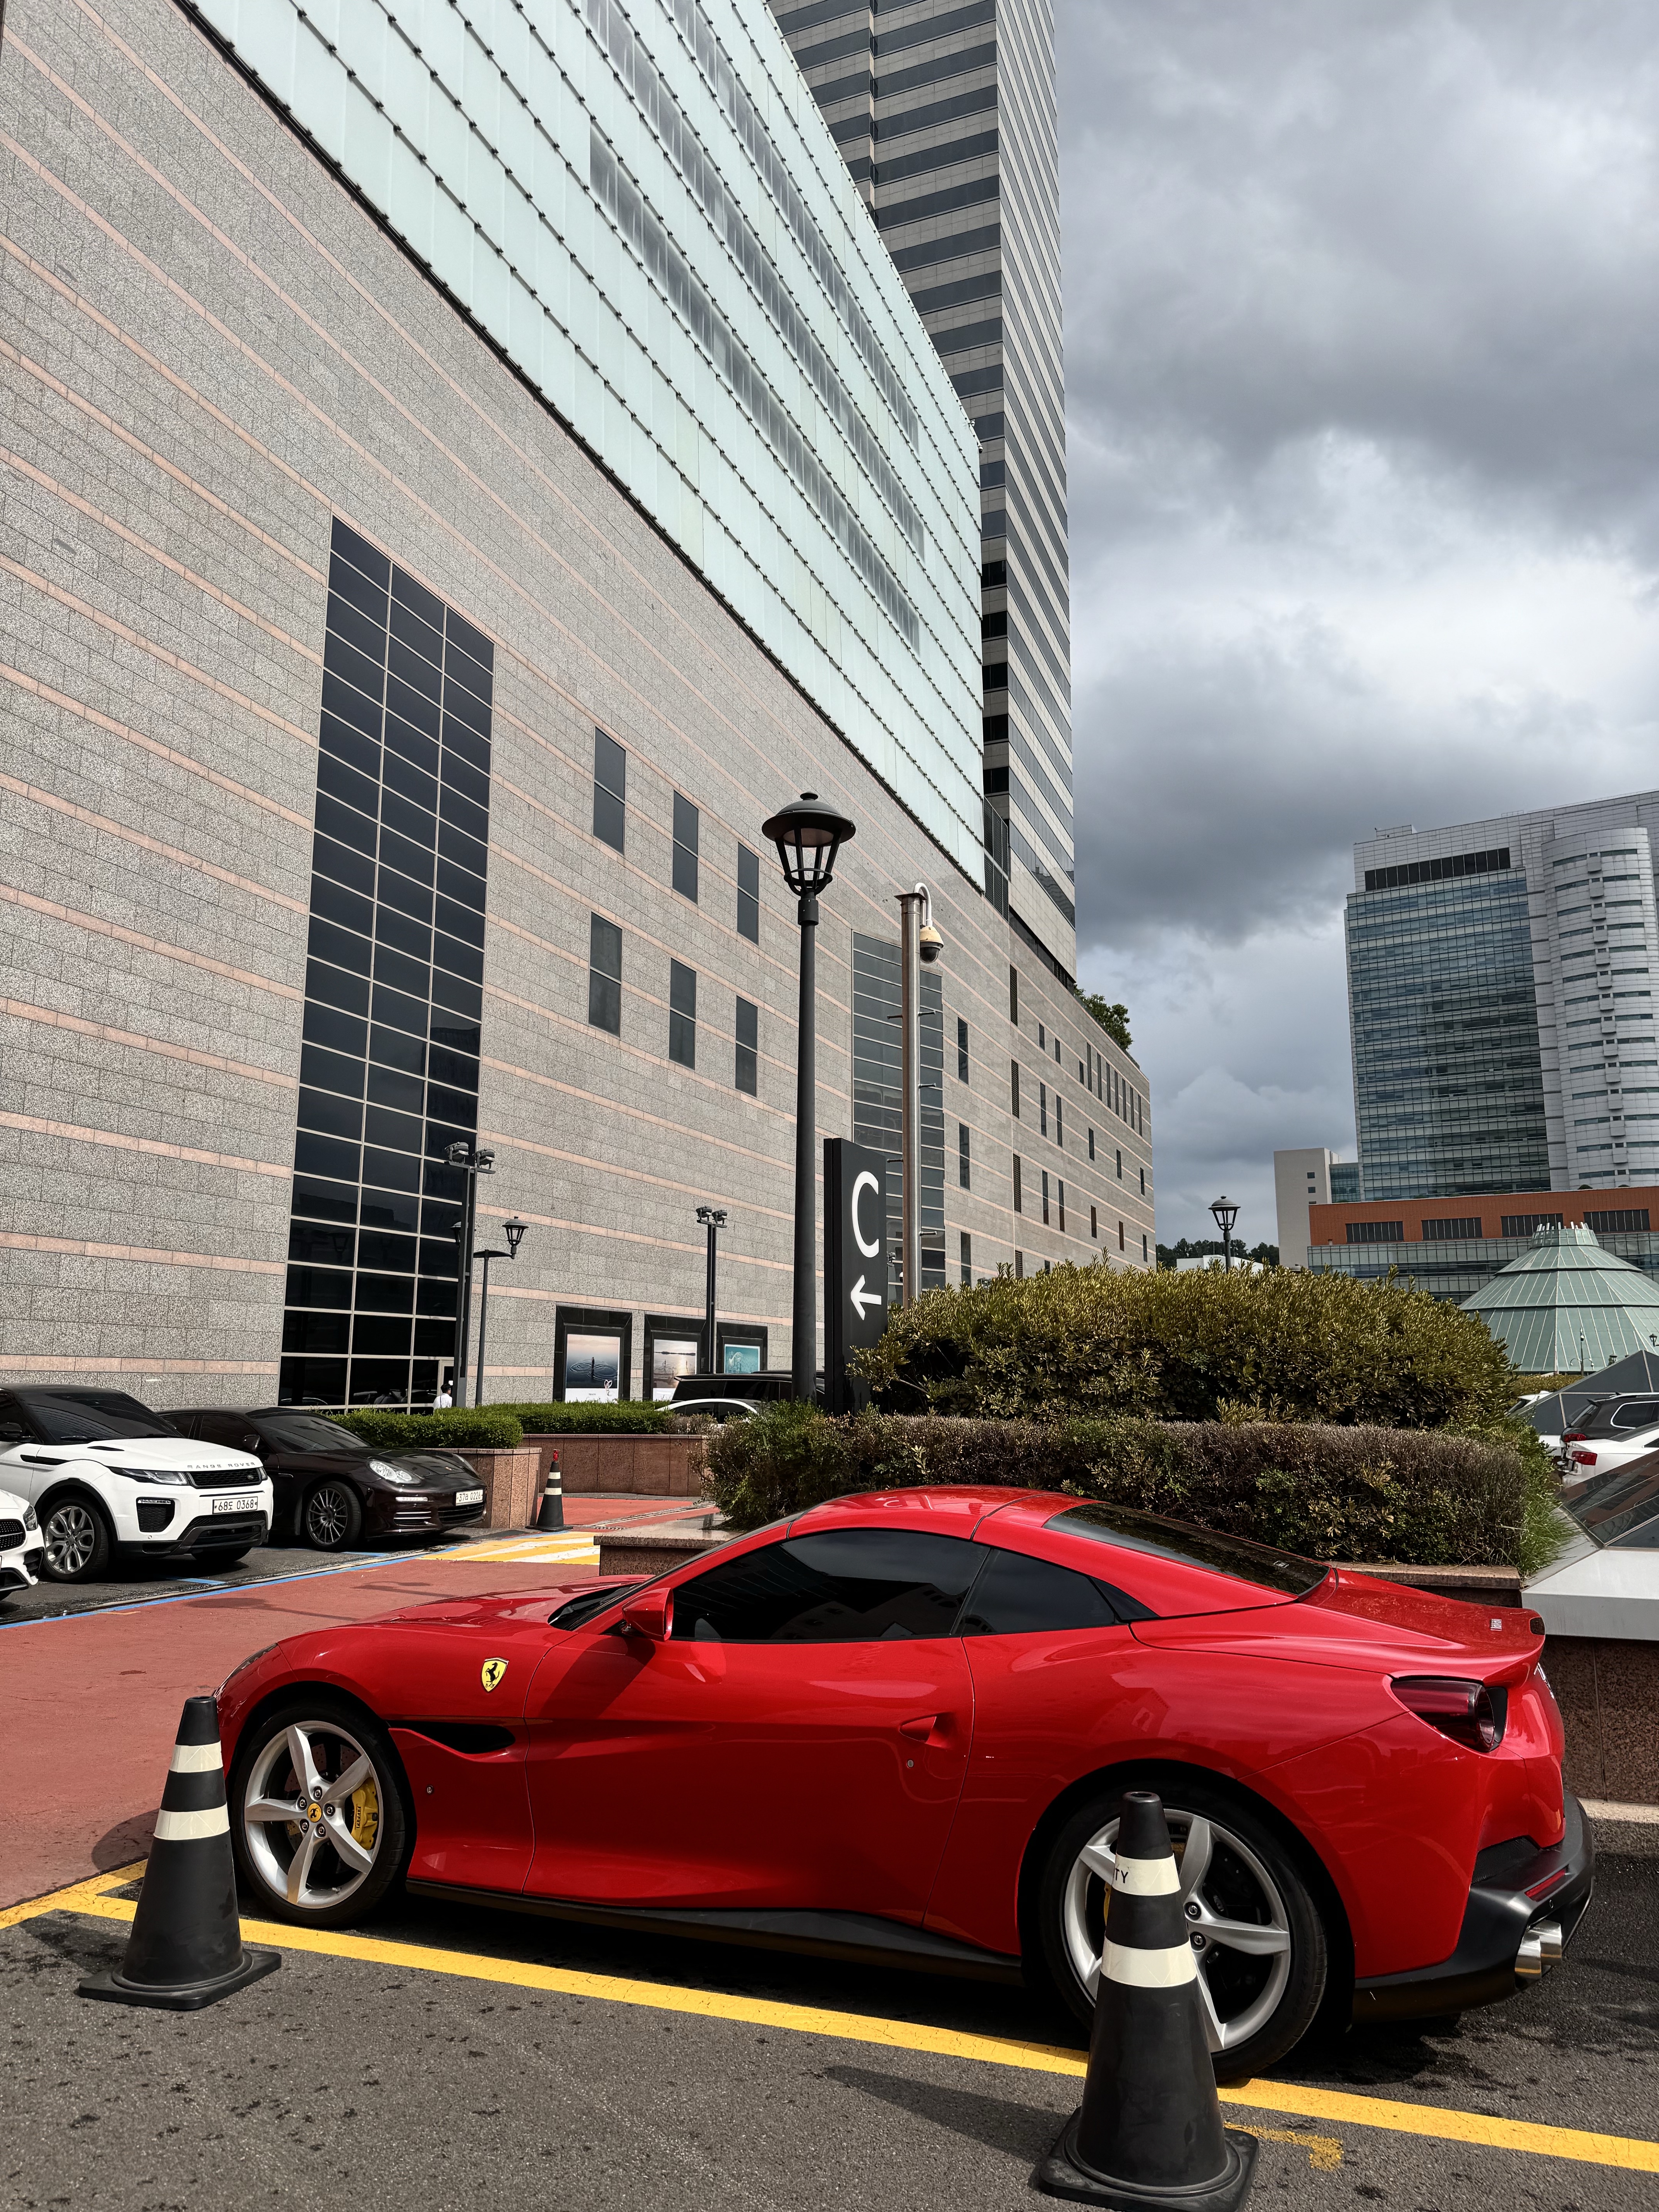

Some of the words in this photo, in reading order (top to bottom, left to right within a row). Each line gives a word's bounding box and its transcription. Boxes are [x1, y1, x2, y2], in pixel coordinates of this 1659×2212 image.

[852, 1171, 879, 1258] C
[218, 1501, 233, 1511] 68도
[237, 1499, 254, 1510] 0368
